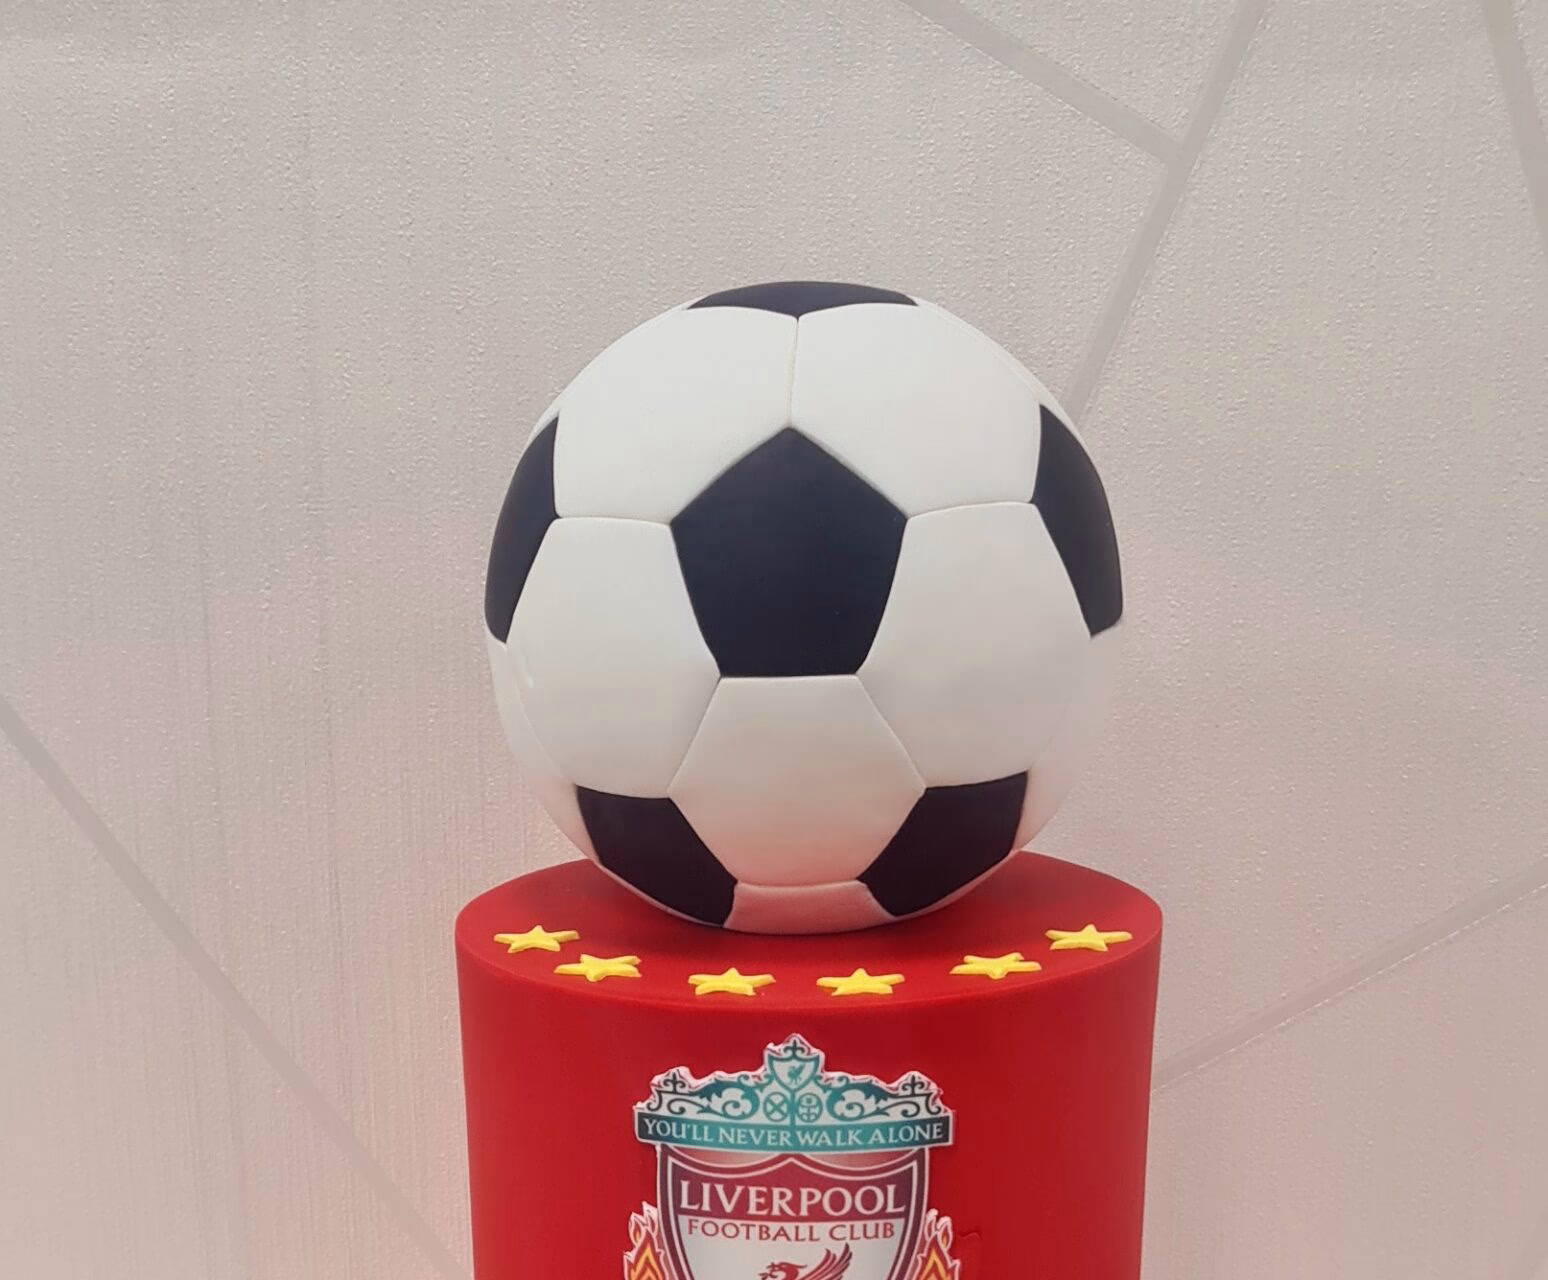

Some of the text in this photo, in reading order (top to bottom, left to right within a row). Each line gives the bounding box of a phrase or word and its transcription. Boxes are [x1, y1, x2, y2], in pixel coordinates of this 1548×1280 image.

[643, 1118, 944, 1147] YOU'LL NEVER WALK ALONE
[679, 1180, 906, 1217] LIVERPOOL
[687, 1220, 895, 1242] FOOTBALL CLUB
